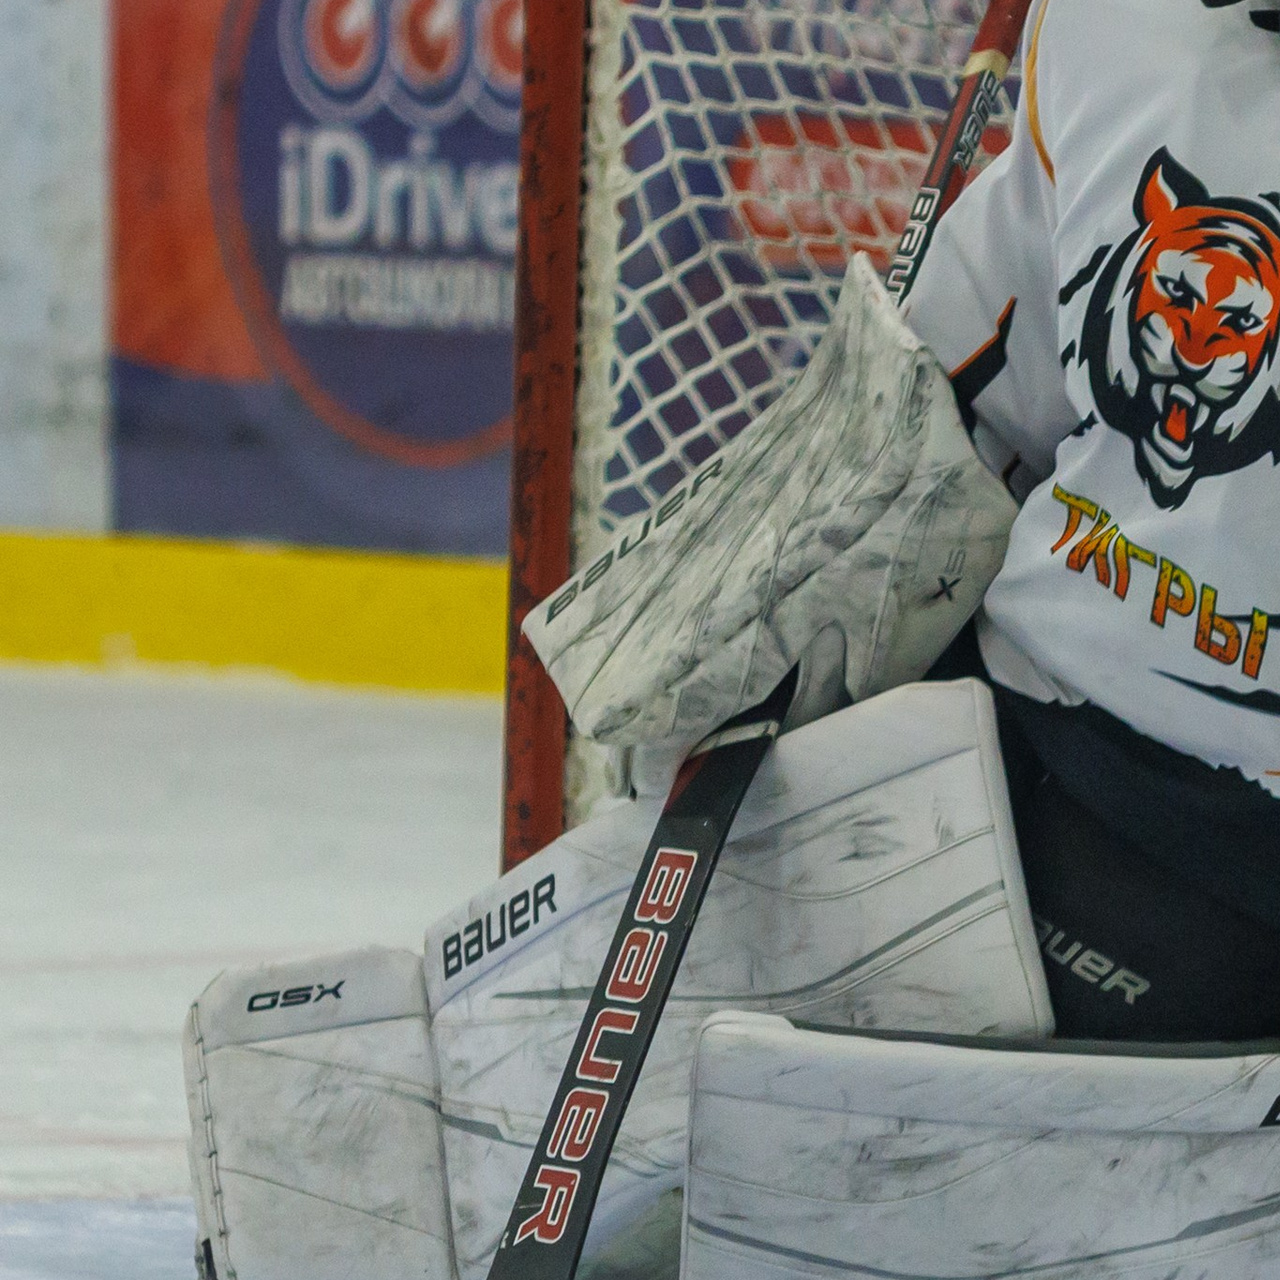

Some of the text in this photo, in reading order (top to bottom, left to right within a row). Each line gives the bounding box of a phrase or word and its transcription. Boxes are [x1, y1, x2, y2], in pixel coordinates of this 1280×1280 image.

[953, 69, 1000, 172] AUER
[279, 122, 518, 250] iDrive
[886, 186, 941, 310] BAU
[545, 456, 724, 625] BAUER
[1050, 482, 1270, 680] ТИГРЫ
[442, 873, 557, 981] BAUER
[1039, 919, 1151, 1005] UER
[513, 847, 698, 1246] BAUER
